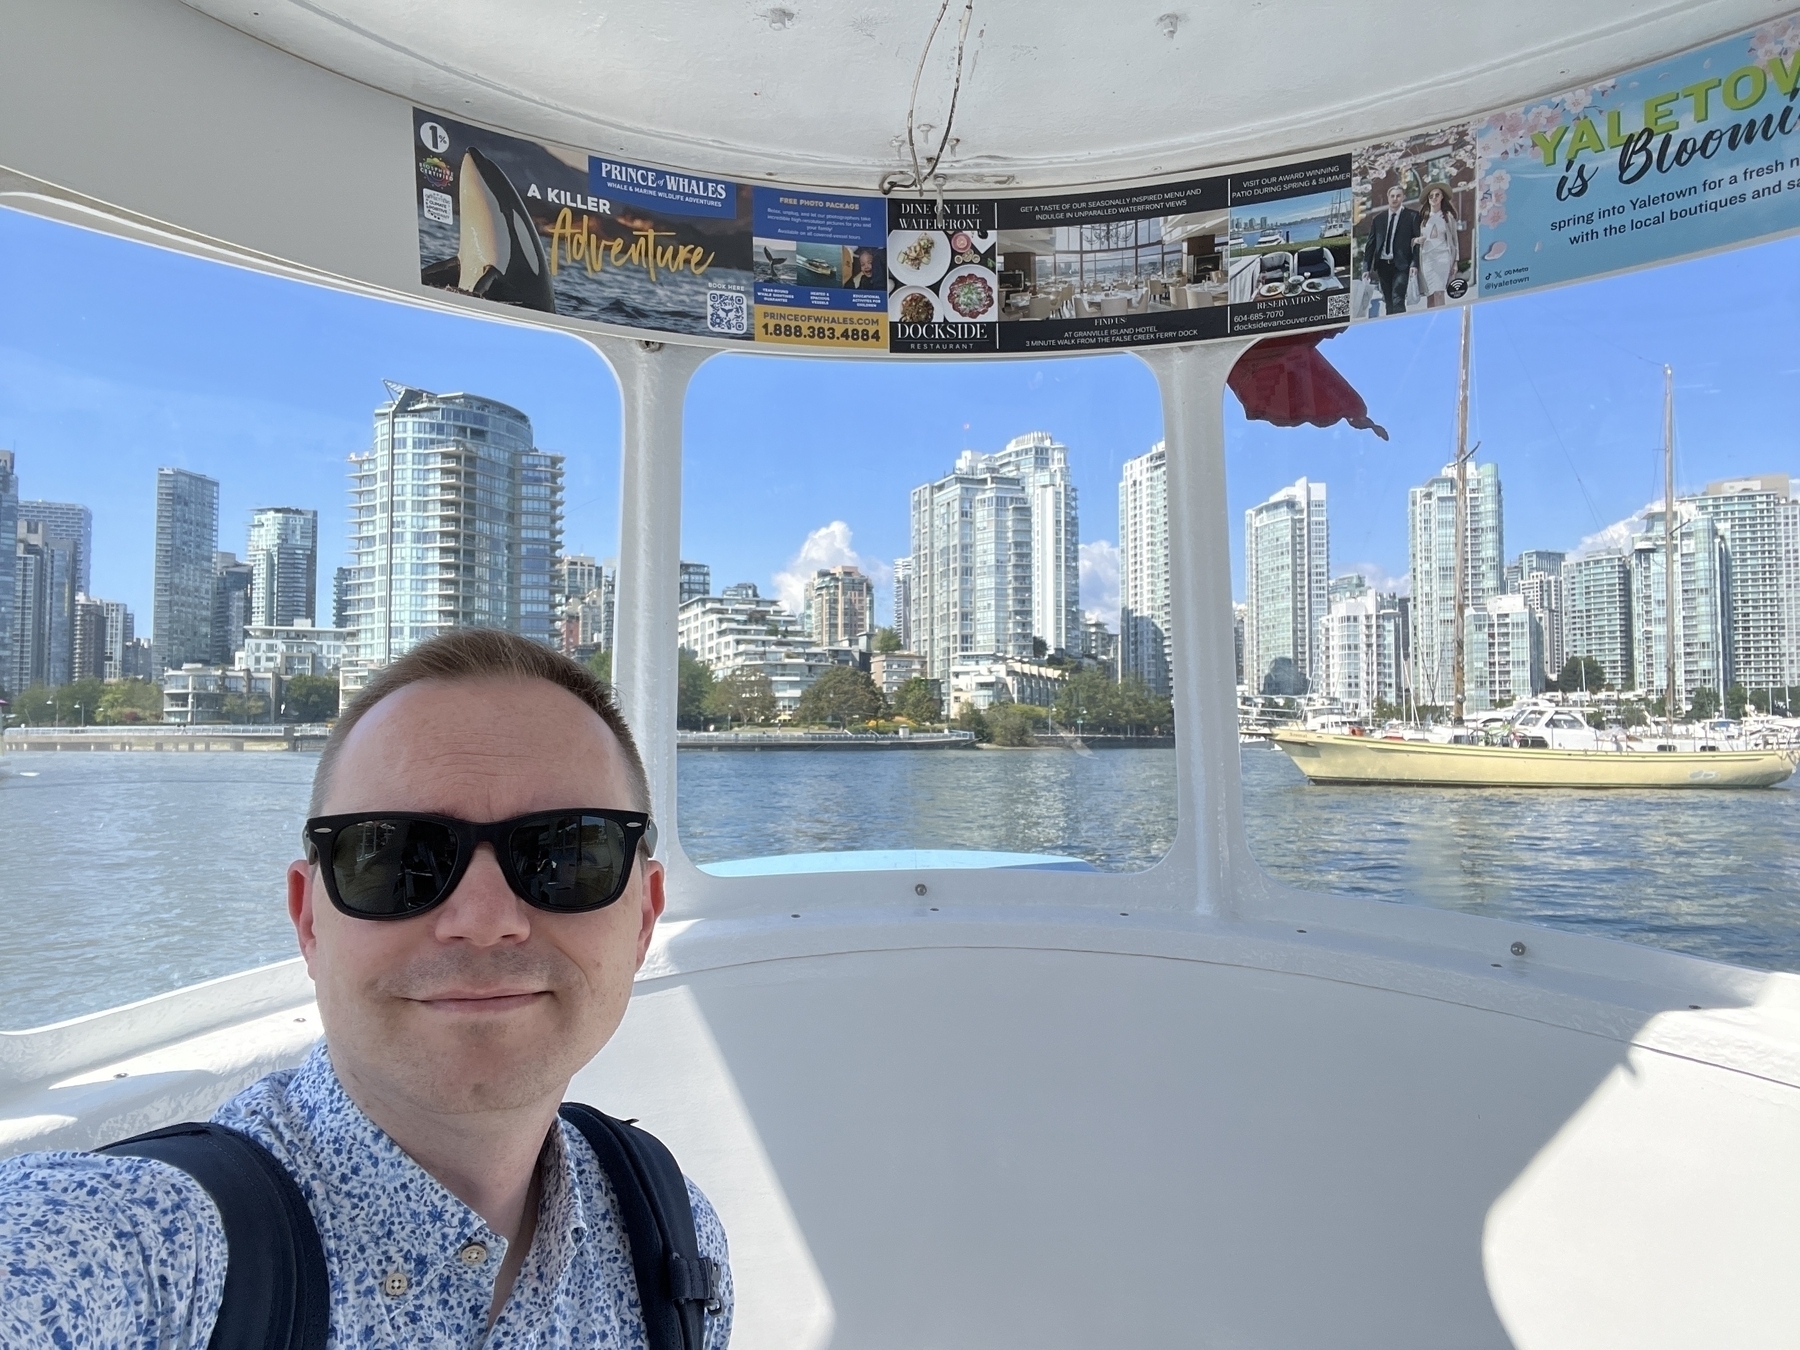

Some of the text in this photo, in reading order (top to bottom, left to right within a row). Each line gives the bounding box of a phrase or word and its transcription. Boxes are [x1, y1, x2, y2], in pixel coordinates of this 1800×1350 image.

[429, 125, 447, 150] 1%
[601, 162, 726, 199] PRINCE of WHALES
[1232, 189, 1252, 198] PATIO
[1253, 185, 1282, 195] DURING
[1283, 180, 1310, 191] SPRING
[1318, 172, 1351, 184] SUMMER
[1242, 166, 1339, 188] VISIT OUR AWARD WINNING
[1556, 158, 1599, 202] is
[527, 184, 611, 214] A KILLER
[607, 181, 628, 190] WHALE
[634, 187, 656, 196] MARINE
[658, 191, 684, 201] WILDLIFE
[685, 196, 722, 207] ADVENTURES
[780, 197, 859, 210] FREE PHOTO PACKAGE
[1088, 198, 1130, 208] SEASONALLY
[1132, 194, 1162, 203] INSPIRED
[1164, 191, 1185, 199] MENU
[1186, 188, 1201, 196] AND
[1550, 211, 1594, 232] spring
[1598, 204, 1625, 220] into
[1630, 186, 1698, 211] Yaletown
[1702, 177, 1724, 193] for
[1728, 176, 1738, 186] a
[1743, 160, 1784, 182] fresh
[902, 204, 931, 214] DINE
[954, 204, 980, 214] THE
[1119, 203, 1164, 214] WATERFRONT
[1165, 200, 1187, 208] VIEWS
[1569, 228, 1599, 246] with
[1603, 222, 1626, 238] the
[1631, 212, 1665, 231] local
[1670, 192, 1746, 222] boutiques
[1751, 180, 1782, 199] and
[548, 207, 715, 282] Adventure
[708, 282, 726, 290] BOOK
[763, 312, 879, 326] PRINCEOFWHALES.COM
[1094, 318, 1113, 326] FIND
[1234, 310, 1284, 322] 604-685-7070
[1234, 314, 1327, 331] docksidevancouver.com
[762, 323, 880, 342] 1.888.383.4884
[898, 324, 987, 339] DOCKSIDE
[1133, 333, 1155, 341] CREEK
[1178, 329, 1198, 337] DOCK
